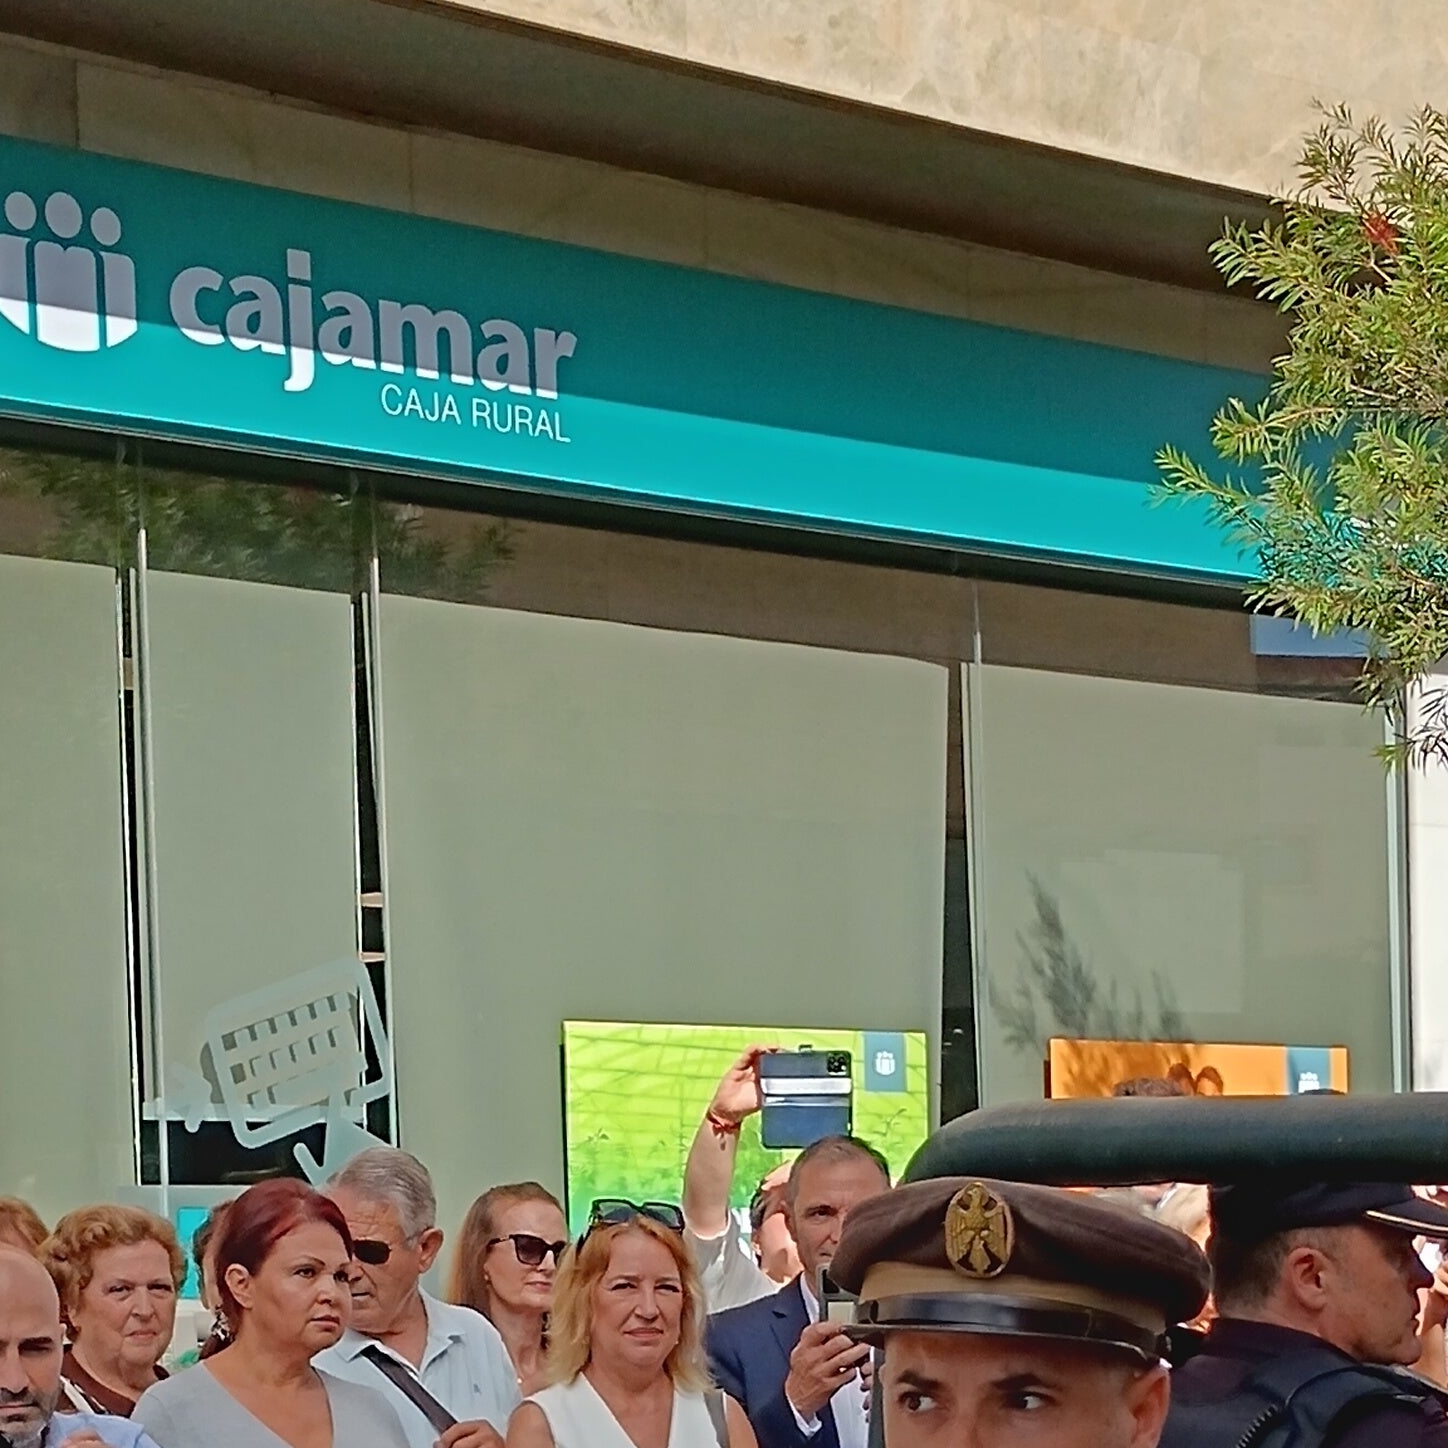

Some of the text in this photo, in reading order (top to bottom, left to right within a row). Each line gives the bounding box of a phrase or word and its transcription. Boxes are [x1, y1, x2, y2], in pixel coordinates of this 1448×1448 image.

[169, 248, 578, 400] cajamar
[380, 382, 572, 443] CAJA RURAL
